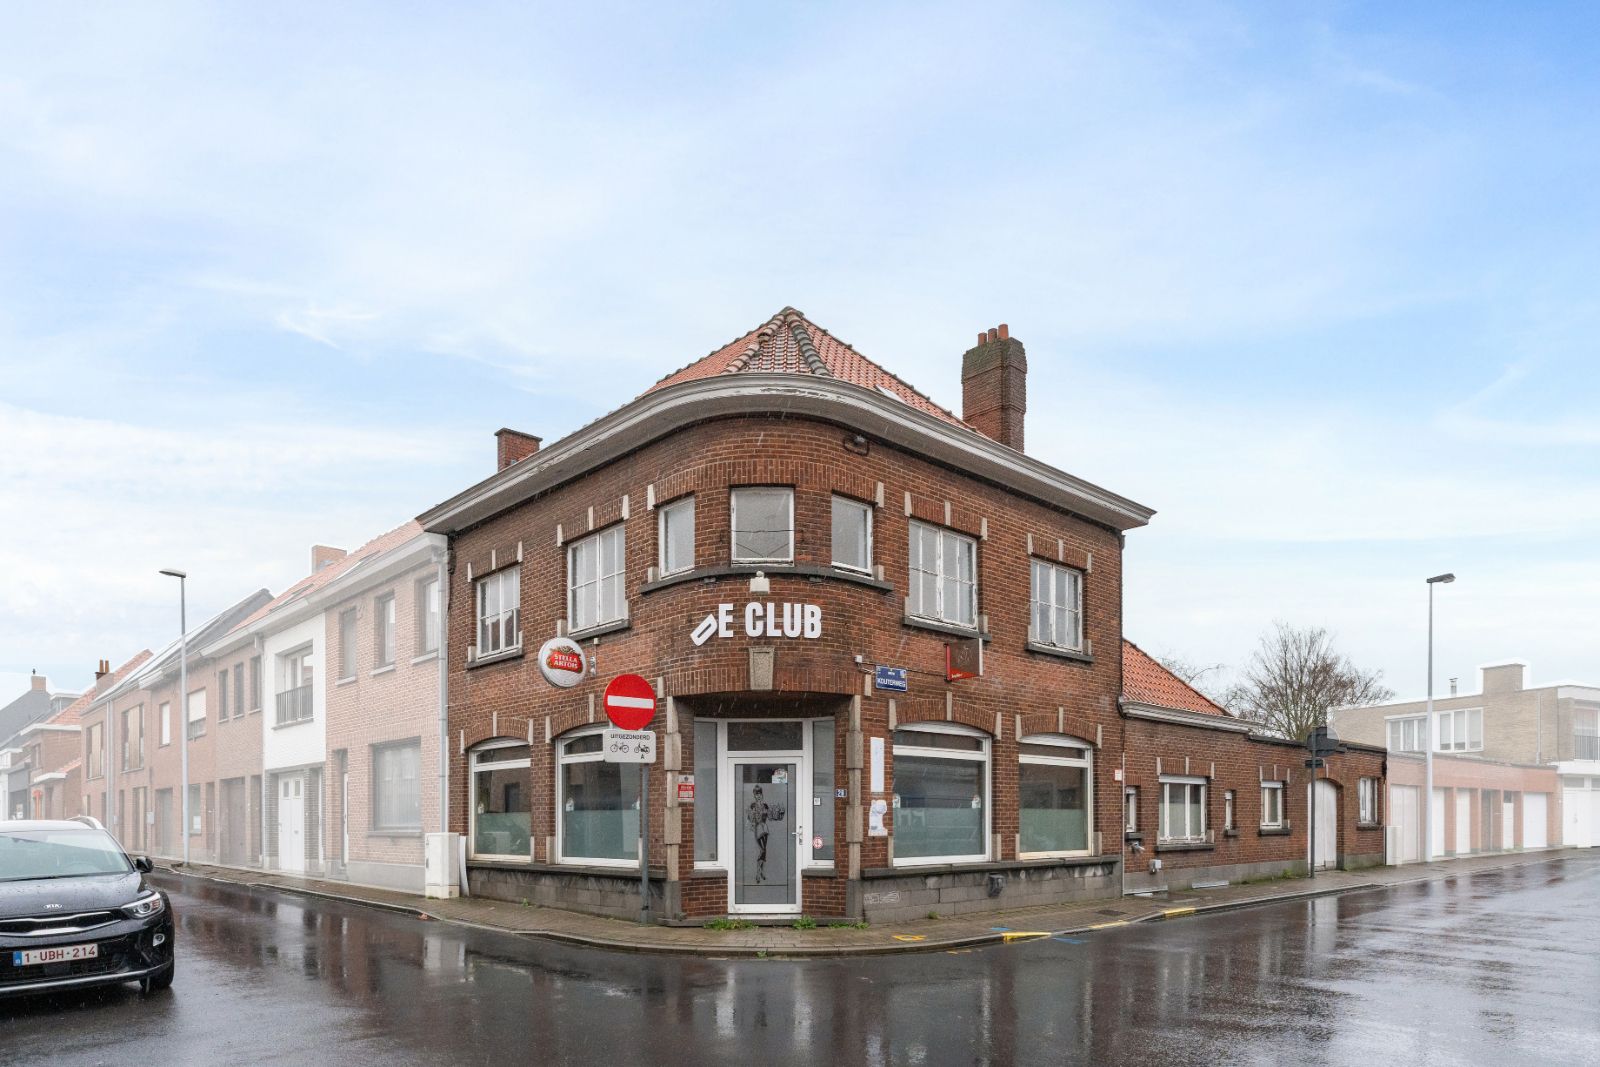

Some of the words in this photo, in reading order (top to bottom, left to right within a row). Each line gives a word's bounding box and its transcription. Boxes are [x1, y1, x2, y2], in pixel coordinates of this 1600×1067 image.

[690, 603, 734, 646] DE
[745, 602, 822, 638] CLUB
[554, 654, 578, 662] STELLA
[554, 660, 578, 669] ARTOIS
[878, 678, 906, 687] KOUTERWEG
